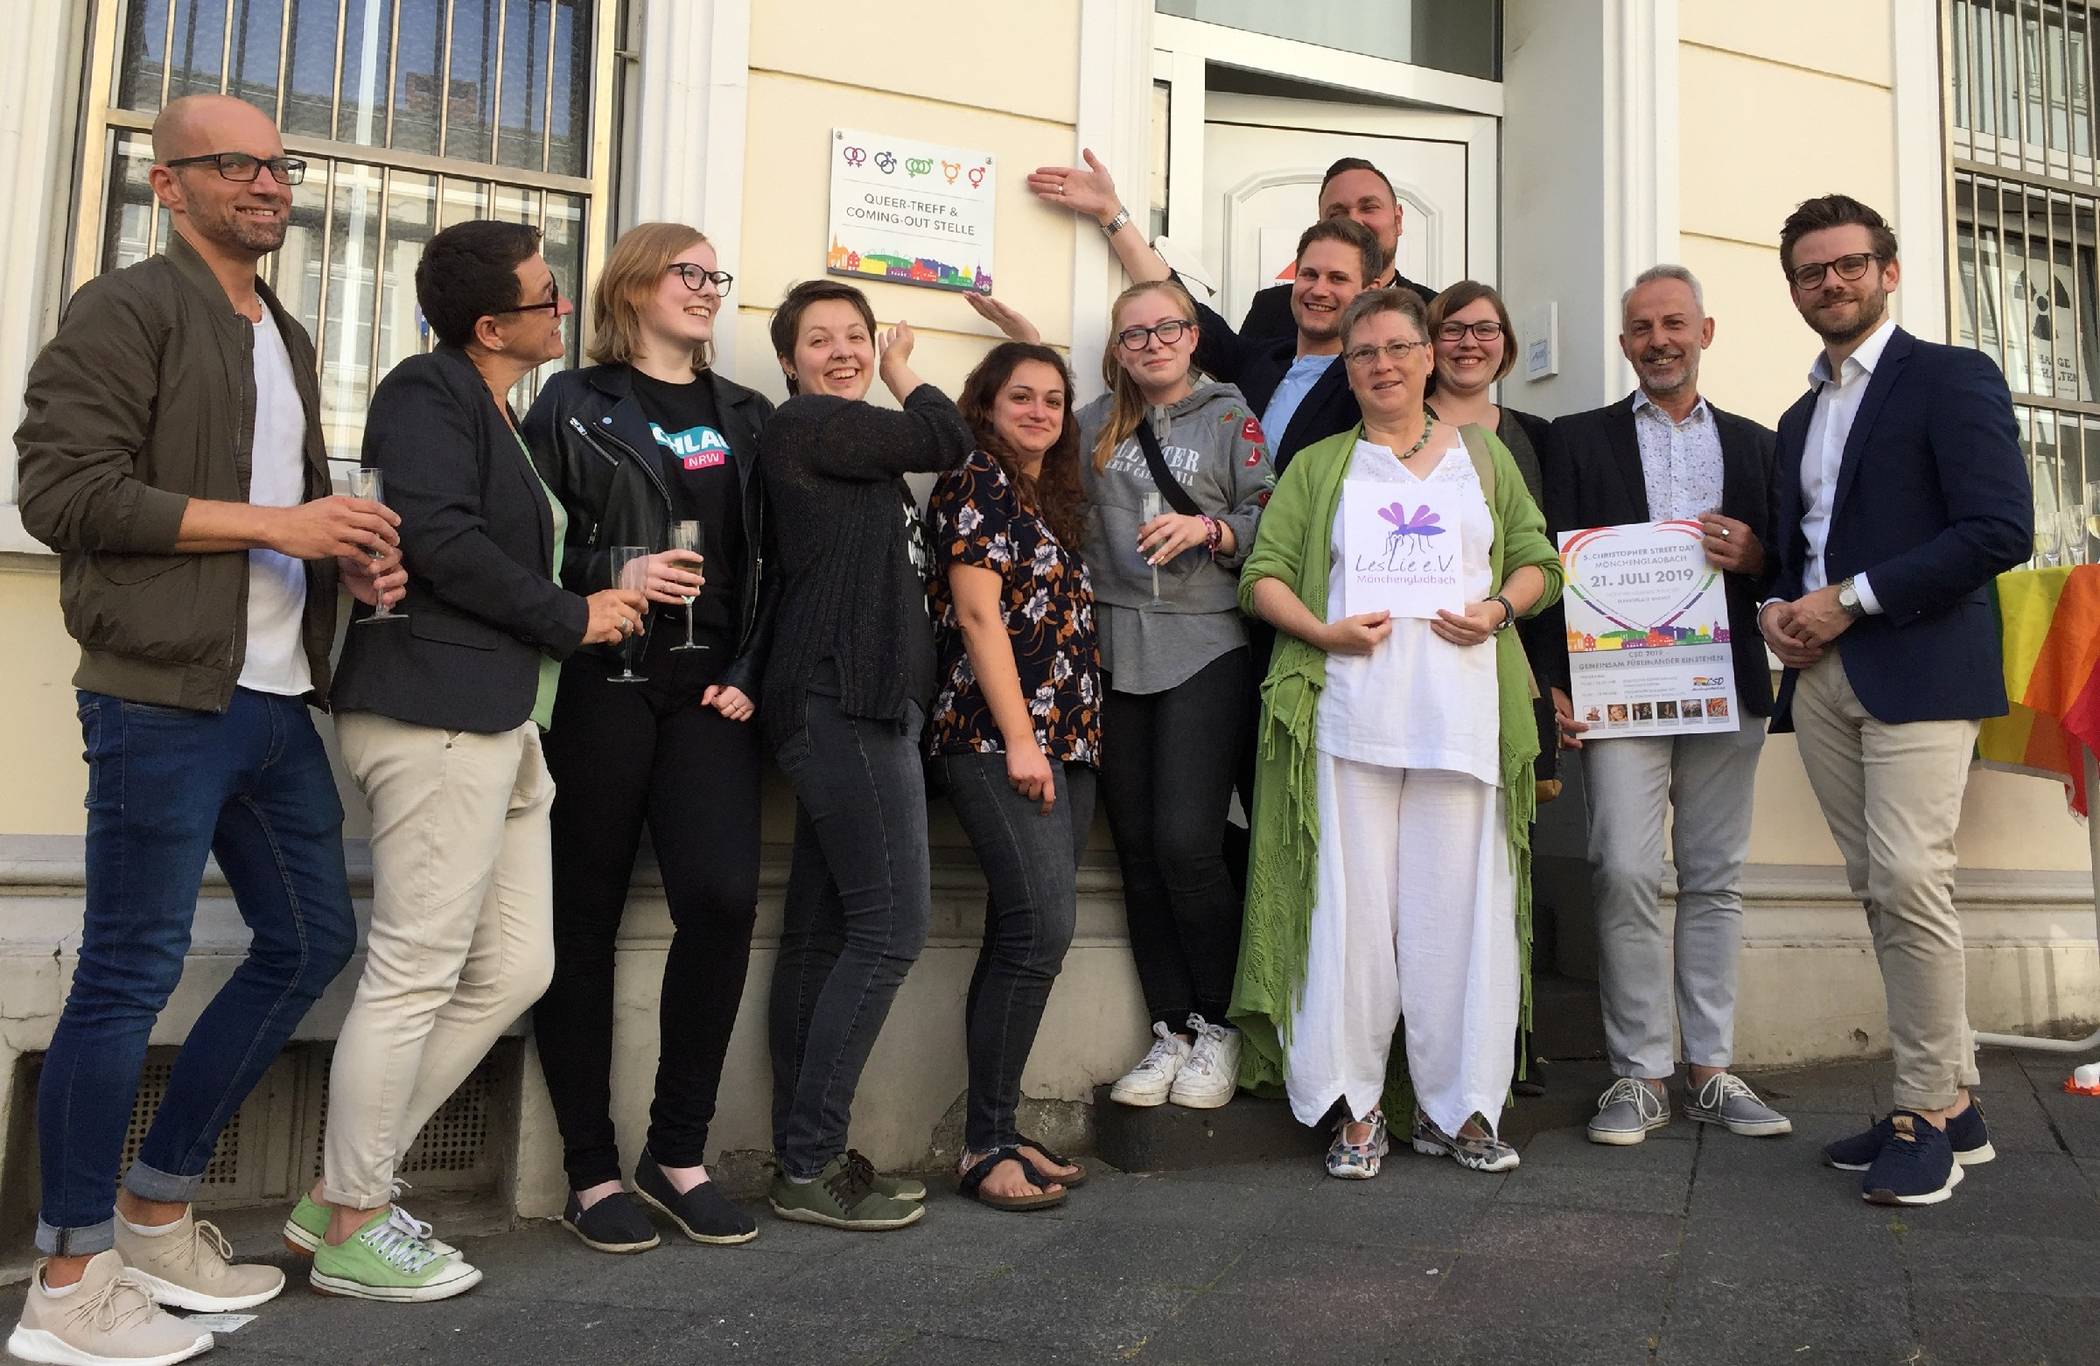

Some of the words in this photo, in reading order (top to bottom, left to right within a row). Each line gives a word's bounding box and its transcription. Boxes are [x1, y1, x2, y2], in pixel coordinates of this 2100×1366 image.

[864, 193, 946, 215] QUEER-TREFF
[949, 207, 958, 217] &
[846, 206, 931, 229] COMING-OUT
[934, 219, 975, 236] STELLE
[688, 453, 720, 467] NRW
[1592, 548, 1648, 560] CHRISTOPHER
[1650, 545, 1677, 555] STREET
[1679, 543, 1696, 552] DAY
[1594, 555, 1687, 569] MÖNCHENGLADBACH
[1356, 575, 1456, 586] Mönchengladbach
[1590, 575, 1613, 588] 21.
[1617, 572, 1650, 586] JULI
[1655, 568, 1694, 584] 2019
[1578, 660, 1625, 670] GEMEINSAM
